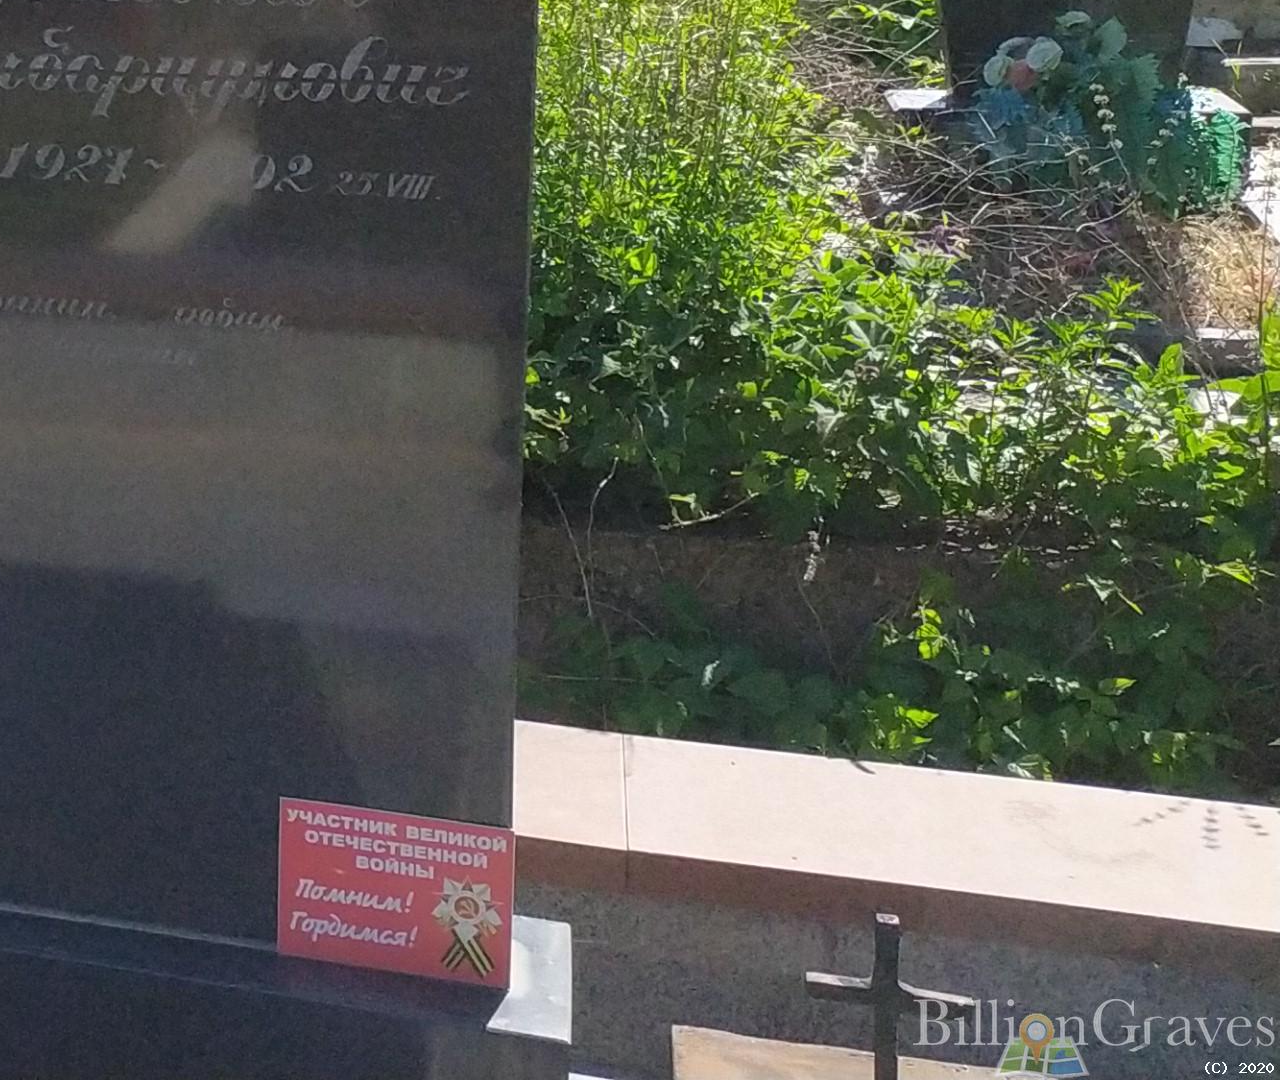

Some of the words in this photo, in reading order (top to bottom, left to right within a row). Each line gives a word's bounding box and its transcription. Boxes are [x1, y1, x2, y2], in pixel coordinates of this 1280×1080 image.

[287, 808, 397, 837] УЧАСТНИК
[405, 825, 508, 853] ВЕЛИКОЙ
[304, 830, 488, 869] ОТЕЧЕСТВЕННОЙ
[355, 855, 434, 880] ВОЙНЫ
[295, 878, 414, 914] Помним!
[289, 911, 418, 949] Гордимся!
